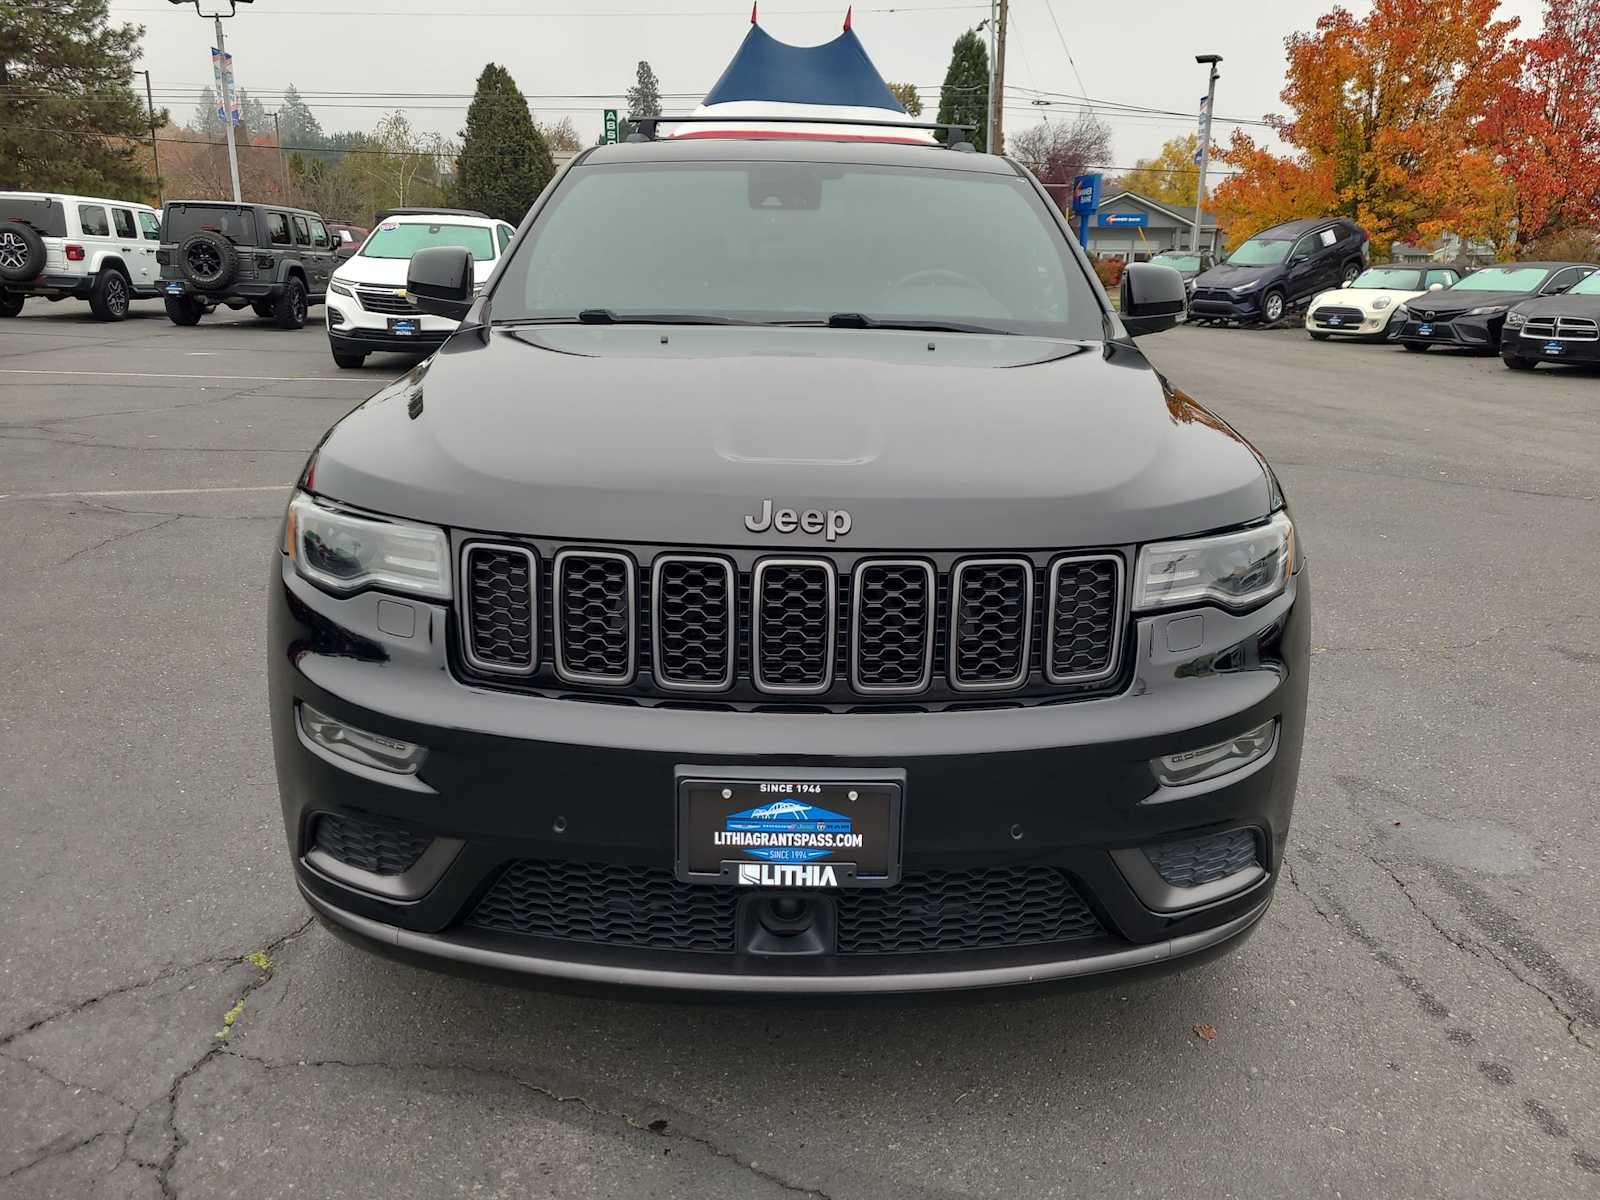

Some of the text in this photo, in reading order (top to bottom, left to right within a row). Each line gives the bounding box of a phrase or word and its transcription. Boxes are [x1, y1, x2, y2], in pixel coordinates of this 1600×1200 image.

[744, 499, 852, 542] Jeep
[760, 784, 822, 793] SINCE 1946
[714, 832, 863, 847] LITHIAGRANTSPASS.COM
[769, 850, 790, 860] SINCE
[761, 864, 838, 887] LITHIA
